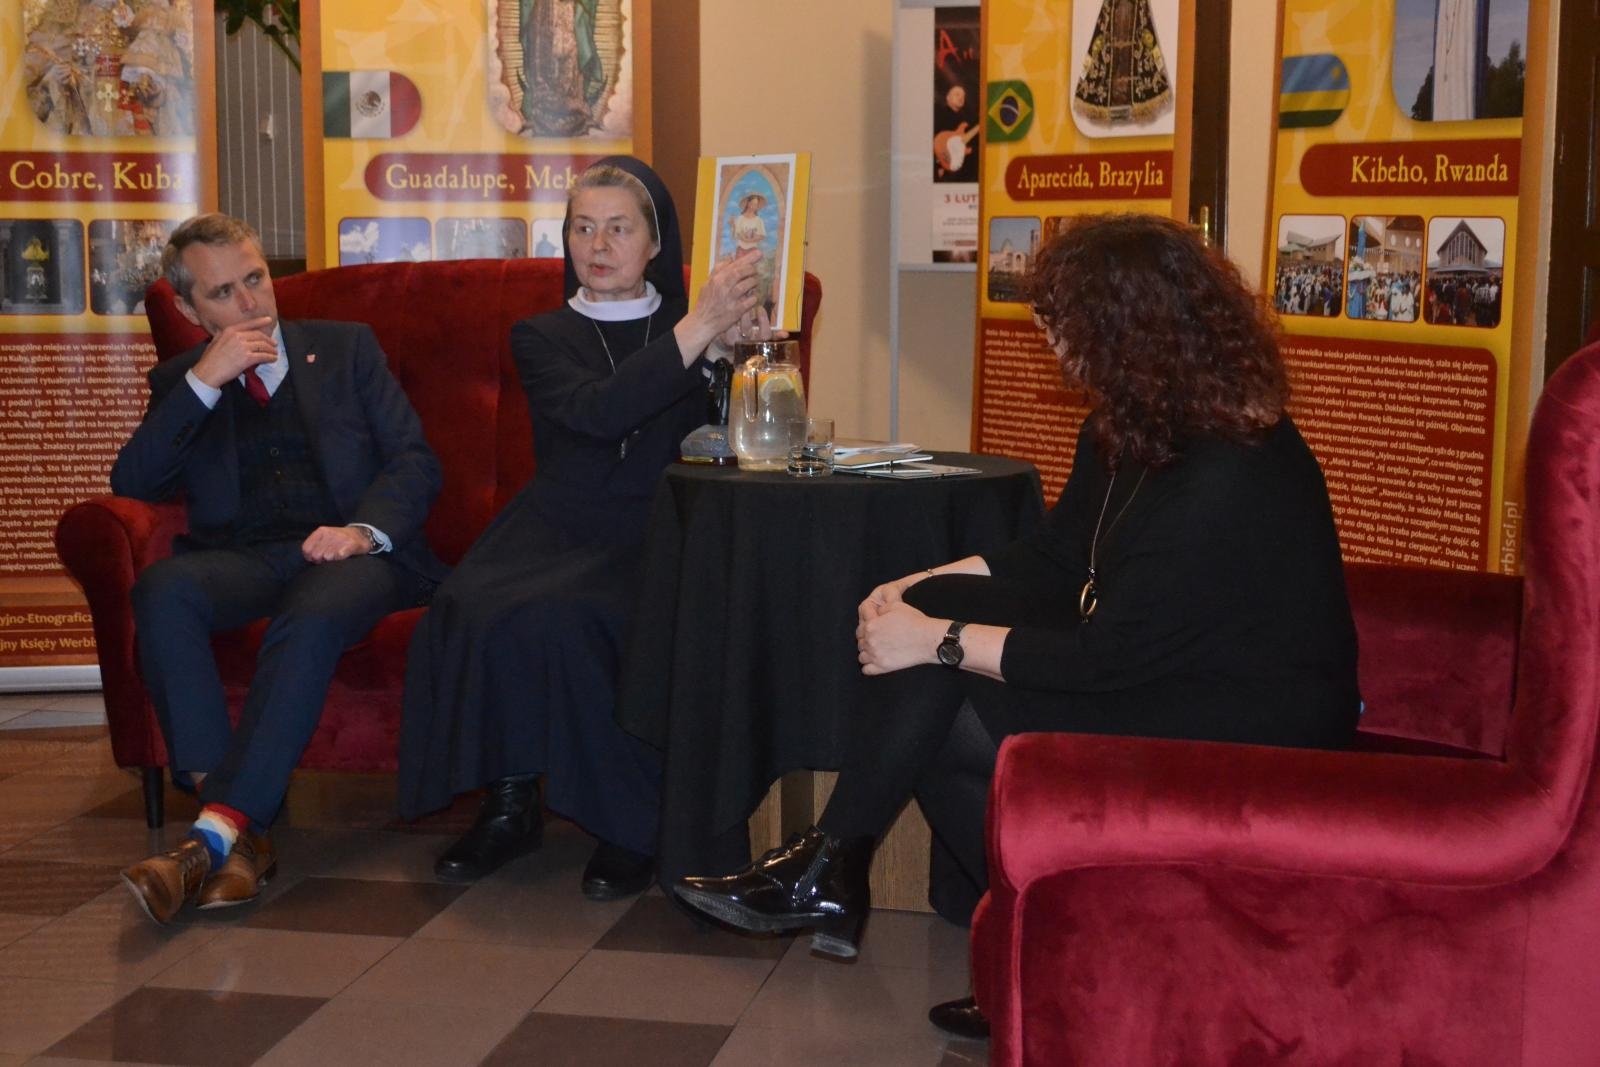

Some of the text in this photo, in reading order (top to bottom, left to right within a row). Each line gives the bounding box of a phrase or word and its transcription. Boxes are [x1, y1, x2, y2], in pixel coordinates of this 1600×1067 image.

[9, 160, 183, 191] Cobre, Kuba
[385, 163, 584, 198] Guadalupe, Mek
[1017, 160, 1163, 197] Aparecida, Brazylia
[1351, 153, 1508, 185] Kibeho, Rwanda
[20, 638, 57, 652] Księży
